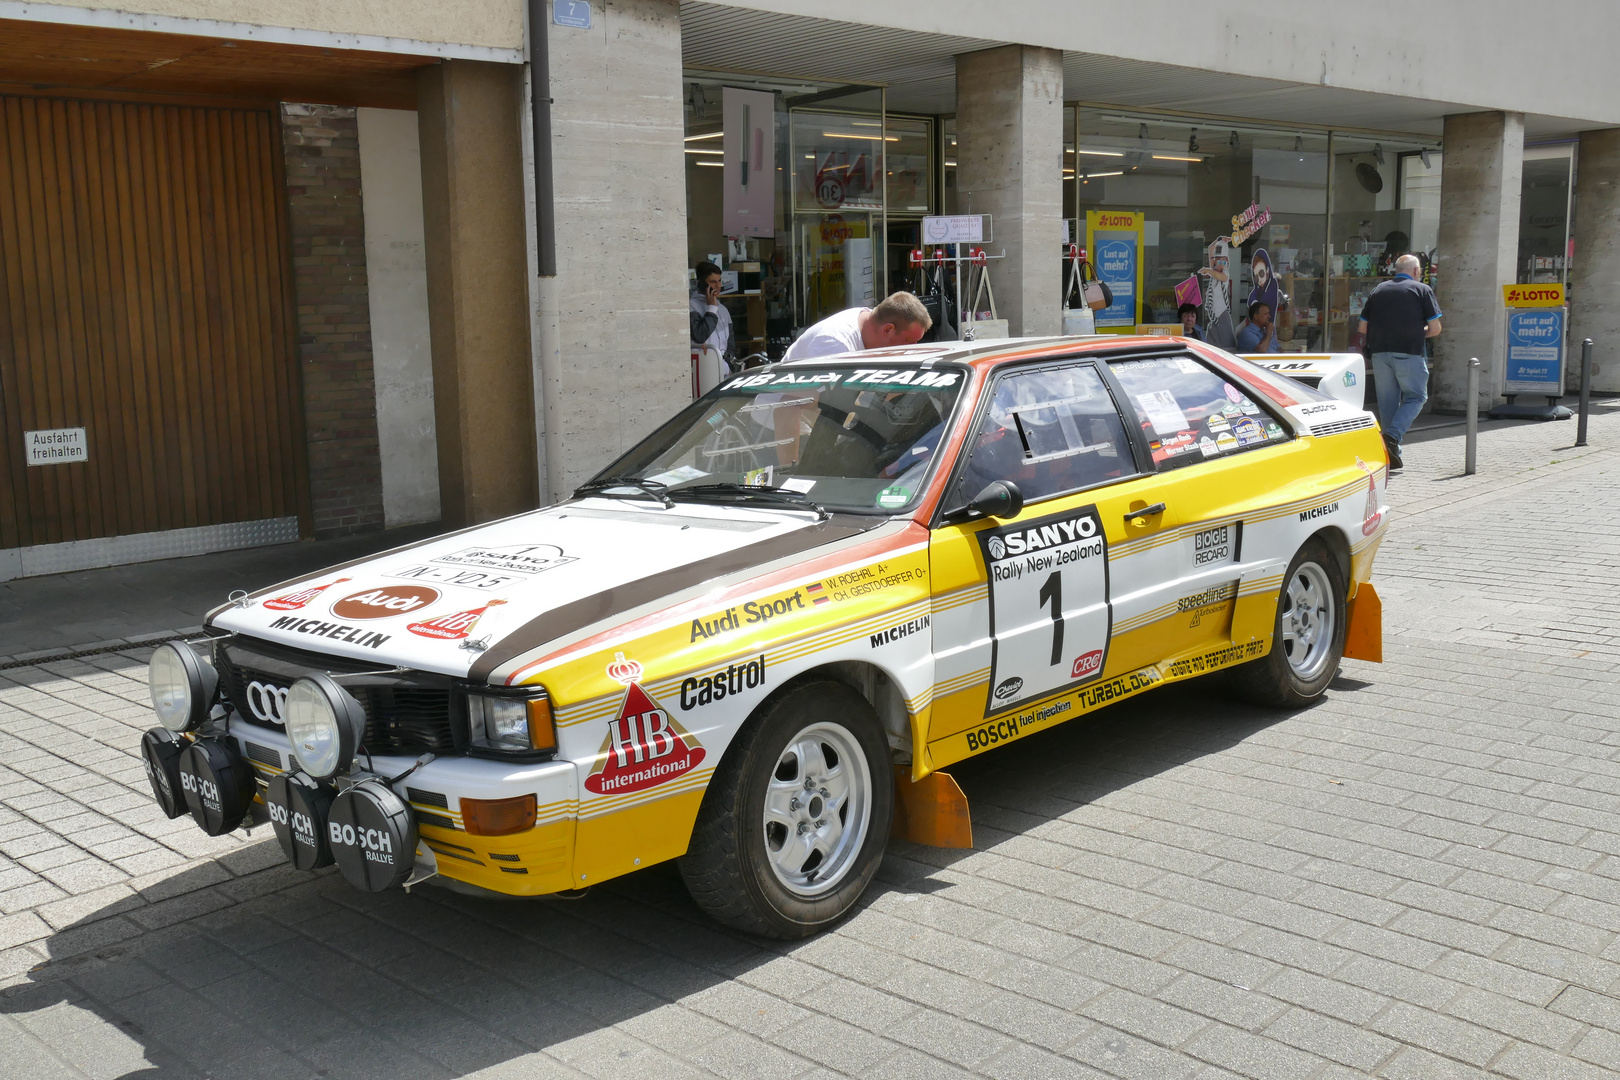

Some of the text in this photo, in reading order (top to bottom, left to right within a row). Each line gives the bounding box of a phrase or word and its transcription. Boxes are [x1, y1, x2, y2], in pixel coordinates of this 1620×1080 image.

[569, 2, 576, 16] 7
[1110, 216, 1132, 226] LOTTO
[1232, 205, 1272, 248] Checker!
[1104, 250, 1128, 258] Lust auf
[1104, 260, 1128, 270] mehr?
[1523, 290, 1559, 300] LOTTO
[1518, 326, 1553, 337] mehr?
[720, 369, 960, 390] HB Audi TEAM
[1301, 404, 1336, 416] quattro
[34, 432, 78, 444] Ausfahrt
[33, 446, 82, 459] freihalten
[1165, 446, 1184, 456] Werner
[1300, 502, 1339, 522] MICHELIN
[1004, 516, 1096, 555] SANYO
[1196, 526, 1227, 550] BOGE
[482, 550, 549, 563] SANYO
[994, 540, 1102, 582] Rally New Zealand
[1196, 546, 1228, 565] RECARO
[834, 567, 927, 602] CH. GEISTDOERFER O+
[840, 569, 875, 587] ROEHRL
[878, 564, 889, 574] A+
[284, 589, 319, 603] HB
[346, 590, 424, 611] Audi
[1178, 586, 1225, 613] speedline
[429, 612, 480, 630] HB
[690, 590, 805, 643] Audi Sport
[1040, 570, 1064, 666] 1
[268, 616, 392, 649] MICHELIN
[411, 624, 461, 639] international
[870, 615, 930, 649] MICHELIN
[1074, 652, 1101, 674] CRC
[680, 654, 766, 711] Castrol
[966, 701, 1071, 751] BOSCH fuel injection
[608, 708, 675, 769] HB
[601, 754, 691, 792] international
[181, 771, 219, 802] BOSCH
[203, 798, 221, 812] RALLYE
[268, 801, 313, 836] BOSCH
[295, 832, 316, 848] RALLYE
[329, 822, 392, 853] BOSCH
[366, 850, 394, 865] RALLYE
